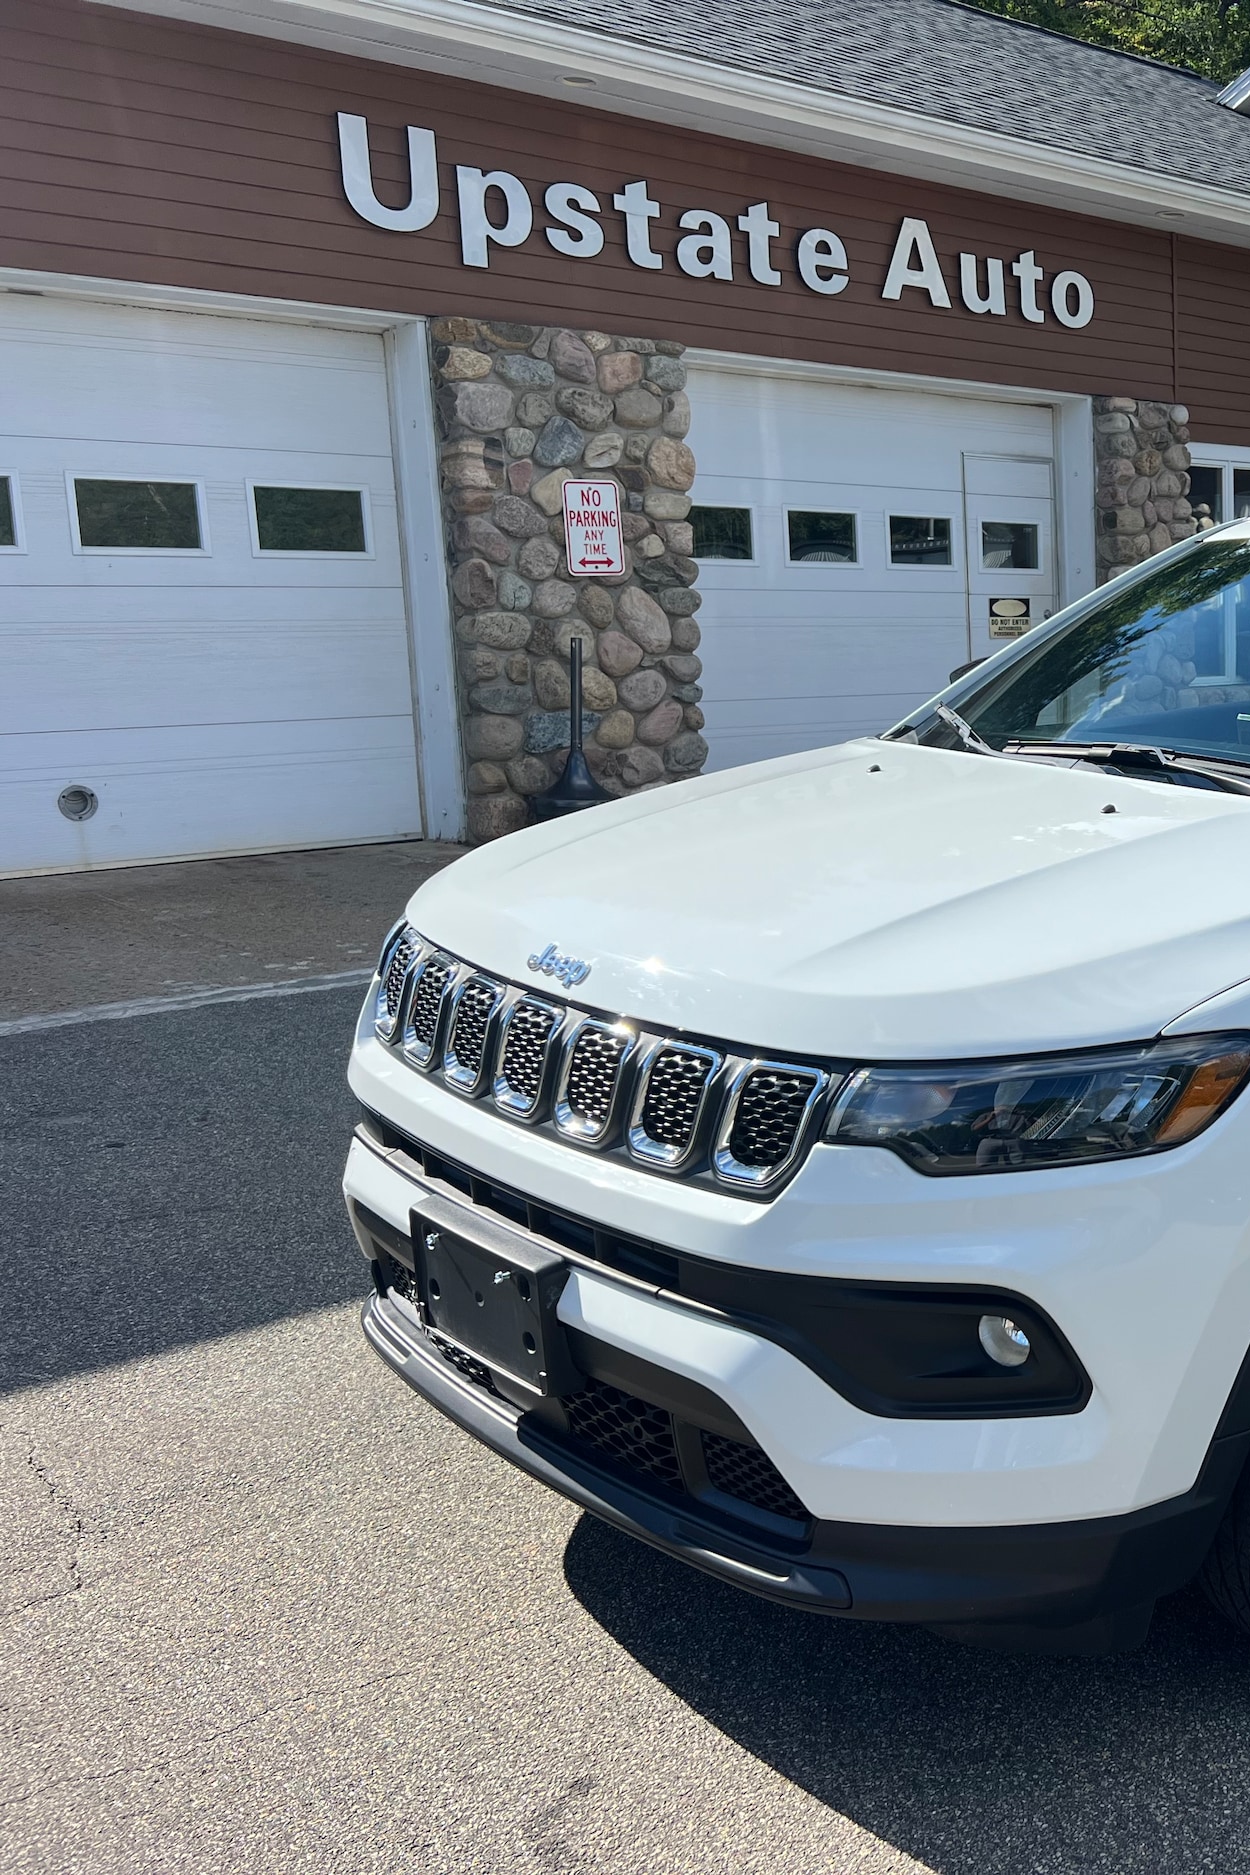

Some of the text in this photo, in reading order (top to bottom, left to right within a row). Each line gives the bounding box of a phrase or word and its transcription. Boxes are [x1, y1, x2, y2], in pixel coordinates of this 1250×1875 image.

[336, 111, 1095, 330] Upstate Auto
[580, 489, 601, 507] NO
[568, 510, 617, 528] PARKING
[584, 530, 605, 541] ANY
[583, 543, 608, 555] TIME
[991, 618, 1029, 626] DO NOT ENTER
[527, 943, 592, 989] Jeep
